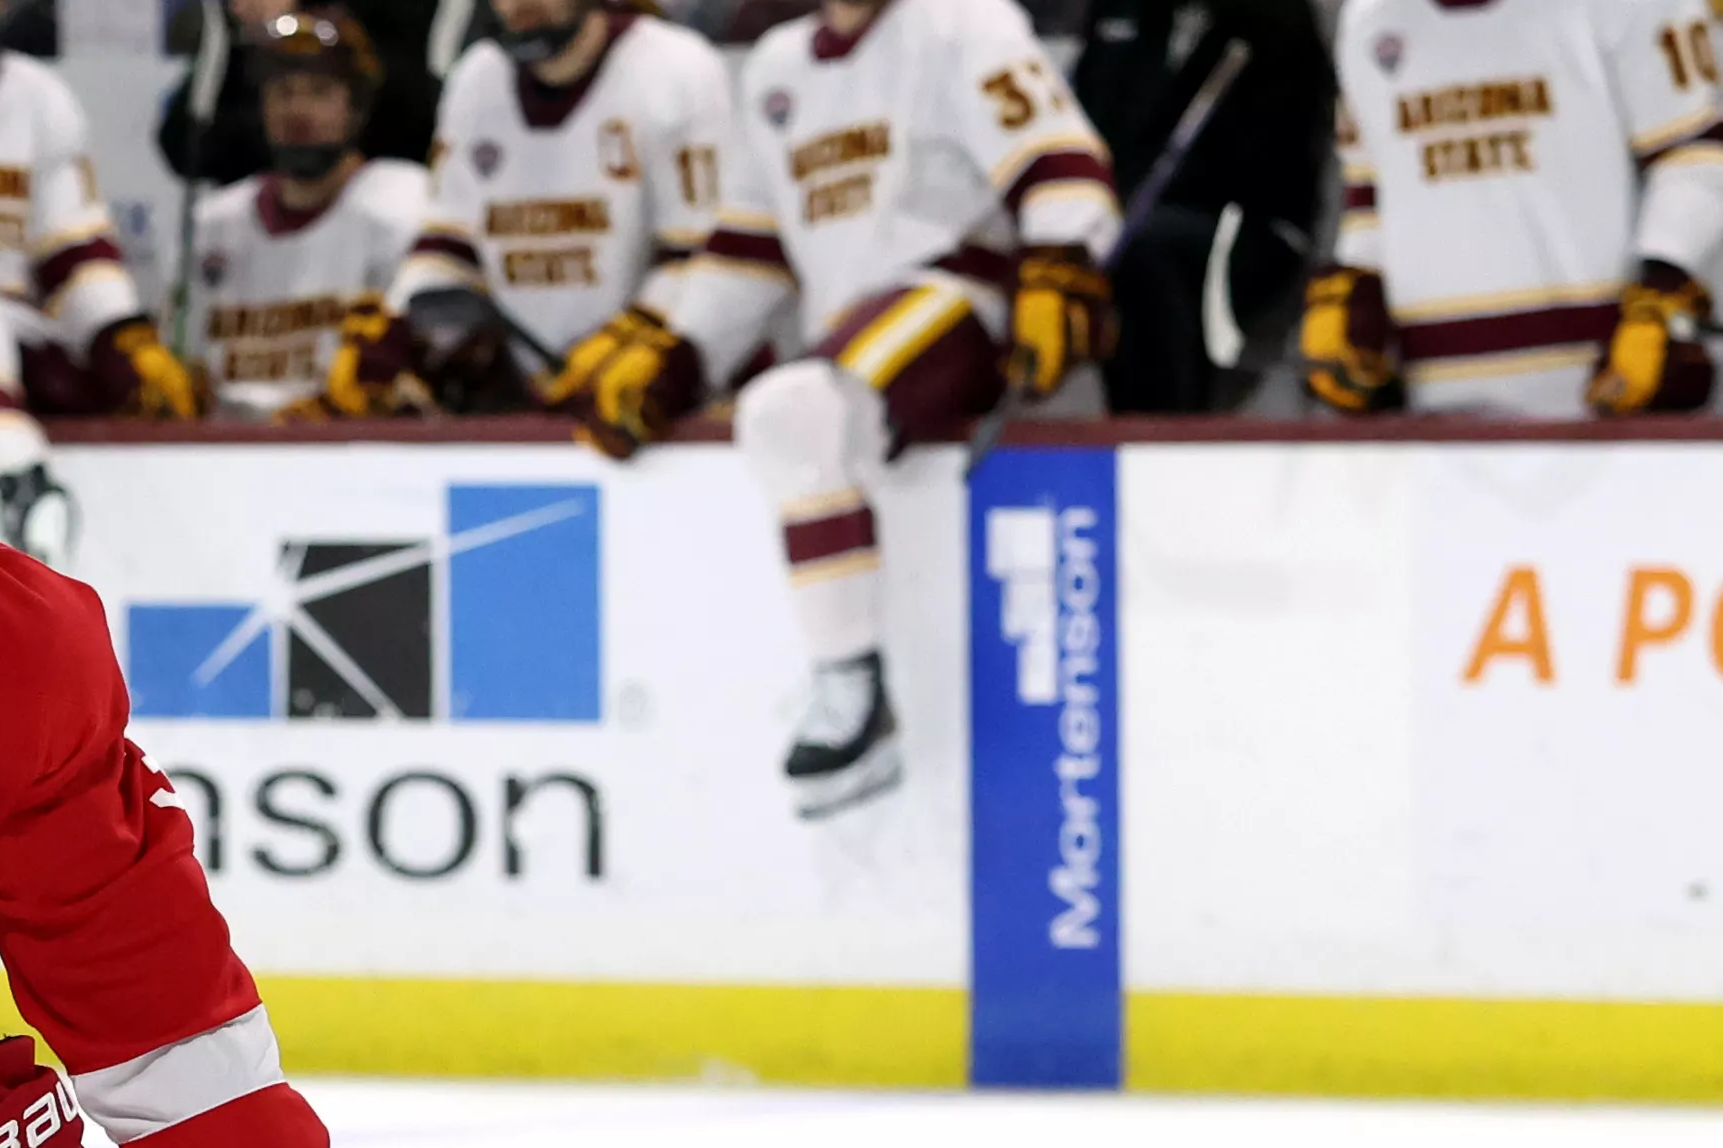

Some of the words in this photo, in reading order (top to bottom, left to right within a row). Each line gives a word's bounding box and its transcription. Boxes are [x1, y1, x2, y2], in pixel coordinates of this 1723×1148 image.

[1394, 78, 1554, 134] ARIZONA
[1420, 131, 1535, 183] STATE
[486, 198, 611, 236] ARIZONA
[1462, 564, 1556, 687] A
[1615, 564, 1723, 687] P
[1049, 504, 1102, 950] Mortenson
[165, 766, 605, 881] nson
